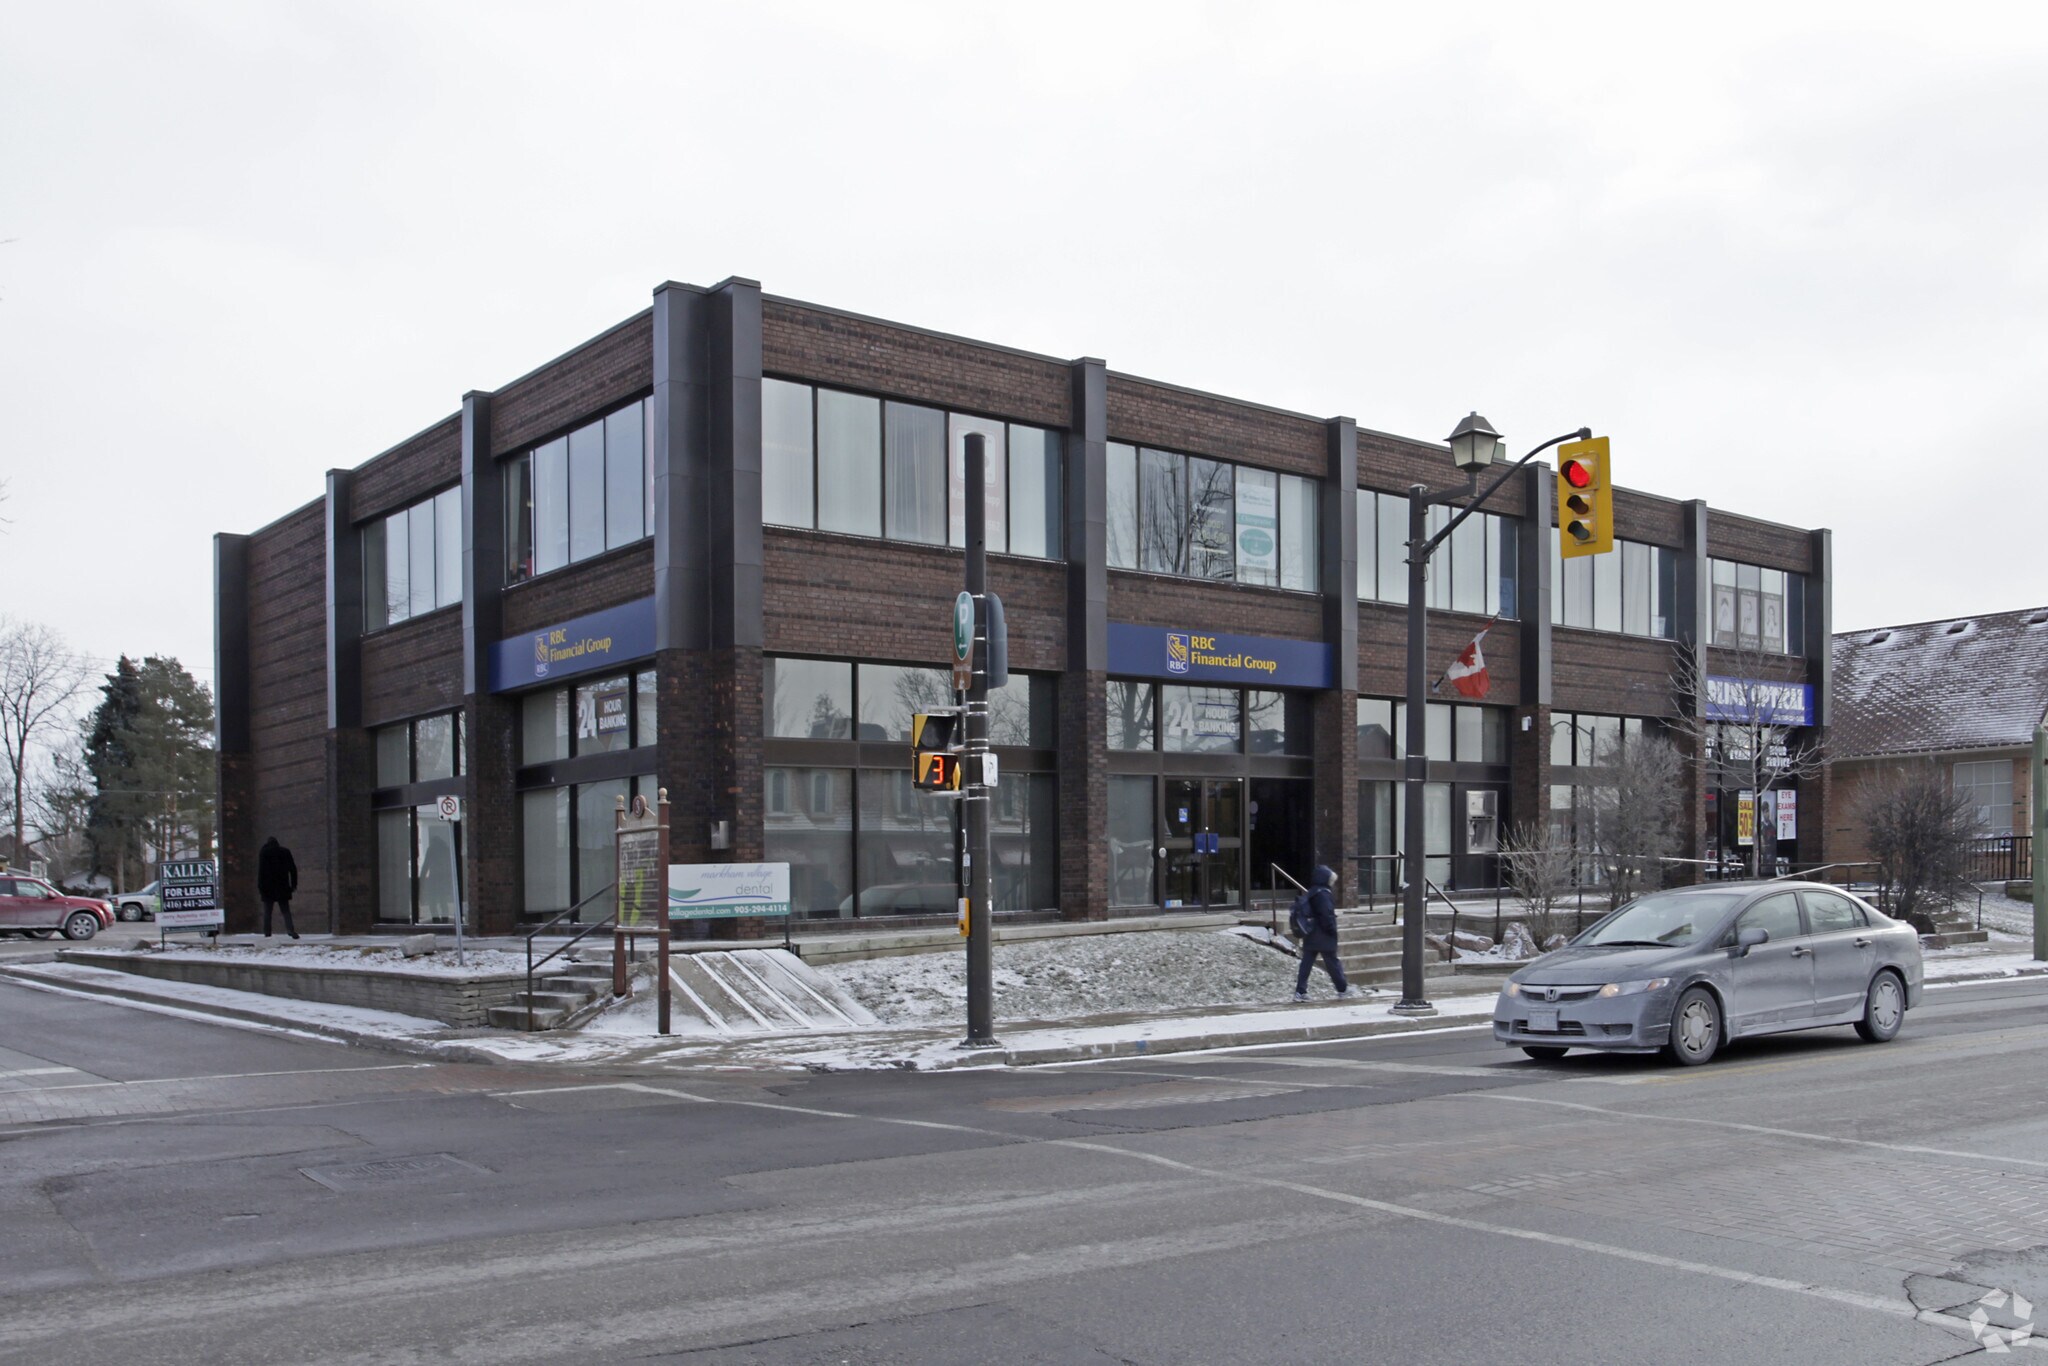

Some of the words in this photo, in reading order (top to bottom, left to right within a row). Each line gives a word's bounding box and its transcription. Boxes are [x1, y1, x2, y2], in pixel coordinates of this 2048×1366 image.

[959, 603, 969, 638] P
[549, 628, 567, 646] RBC
[1191, 635, 1216, 650] RBC
[550, 640, 585, 663] Financial
[586, 636, 612, 654] Group
[536, 662, 549, 673] RBC
[1169, 660, 1187, 671] RBC
[1191, 650, 1242, 668] Financial
[1244, 655, 1277, 674] Group
[603, 698, 622, 713] HOUR
[578, 698, 597, 739] 24
[1168, 700, 1195, 736] 24
[1205, 707, 1229, 719] HOUR
[599, 713, 627, 730] BANKING
[1198, 721, 1236, 734] BANKING
[932, 756, 944, 785] 3
[1781, 791, 1792, 799] EYE
[1777, 802, 1796, 810] EXAMS
[1779, 813, 1794, 821] HERE
[162, 864, 213, 878] KALLES
[700, 864, 744, 880] markham
[745, 864, 773, 884] village
[164, 888, 183, 897] FOR
[184, 887, 212, 896] LEASE
[735, 882, 773, 895] dental
[163, 900, 182, 910] (416)
[183, 899, 215, 908] 441-2888
[733, 903, 788, 914] 905-294-4114
